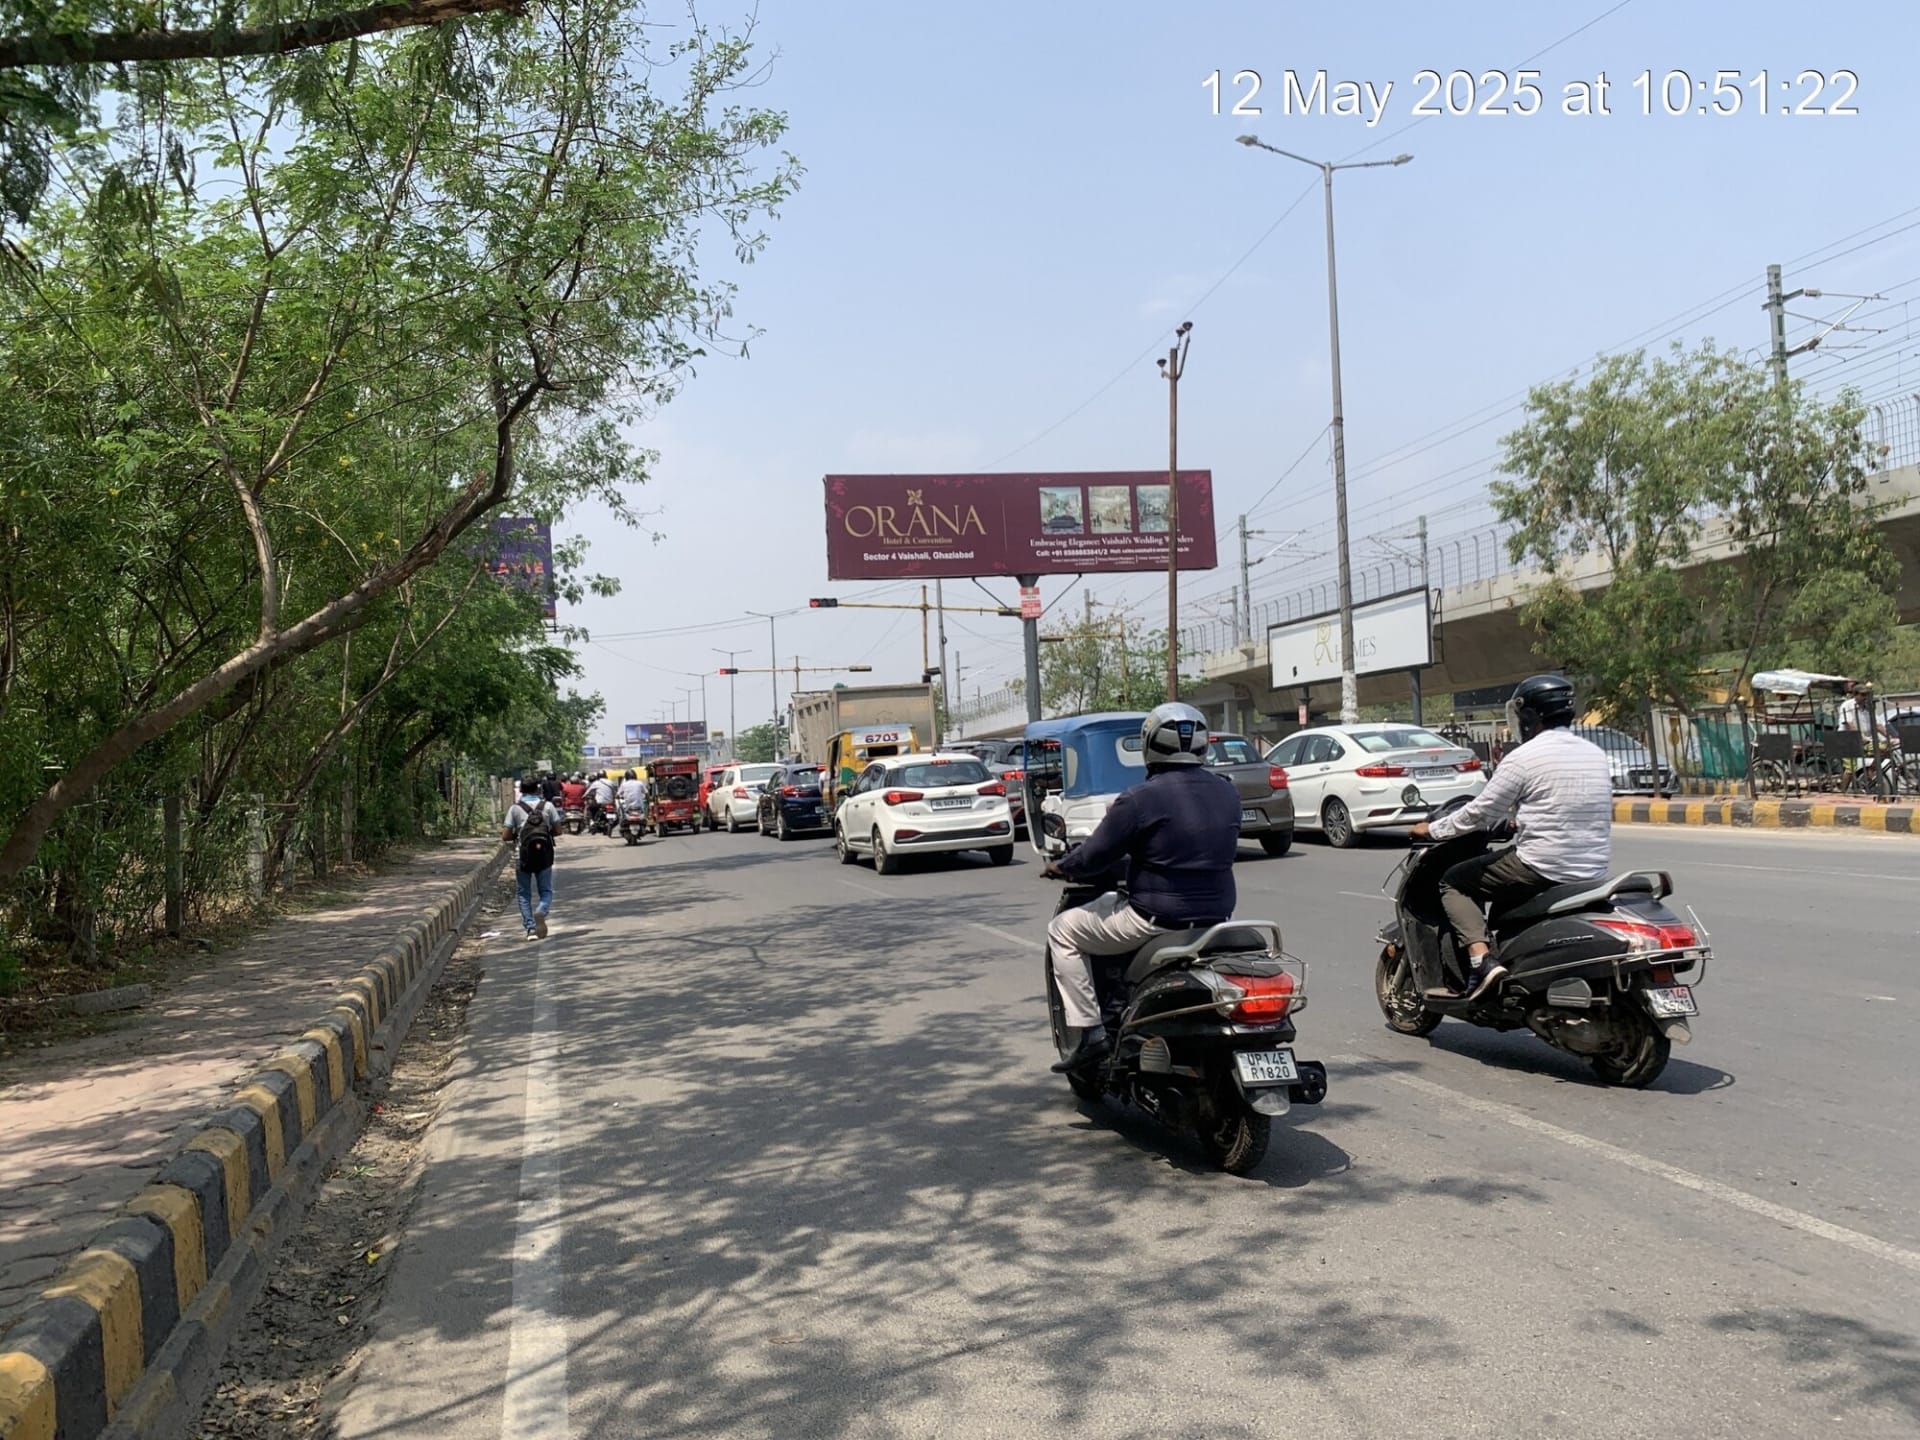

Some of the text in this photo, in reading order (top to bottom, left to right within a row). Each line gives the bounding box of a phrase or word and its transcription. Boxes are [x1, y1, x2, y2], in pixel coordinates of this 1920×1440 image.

[845, 504, 987, 537] ORANA
[883, 537, 902, 545] Hotel
[912, 536, 952, 544] Convention
[1030, 538, 1068, 548] Embracing
[1133, 536, 1163, 546] Wedding
[863, 551, 974, 561] Sector 4 Vaishali, Ghaziabad
[1335, 635, 1377, 662] HMES
[865, 733, 899, 743] 6703
[1247, 1052, 1288, 1066] UP14E
[1251, 1066, 1290, 1080] R1820
